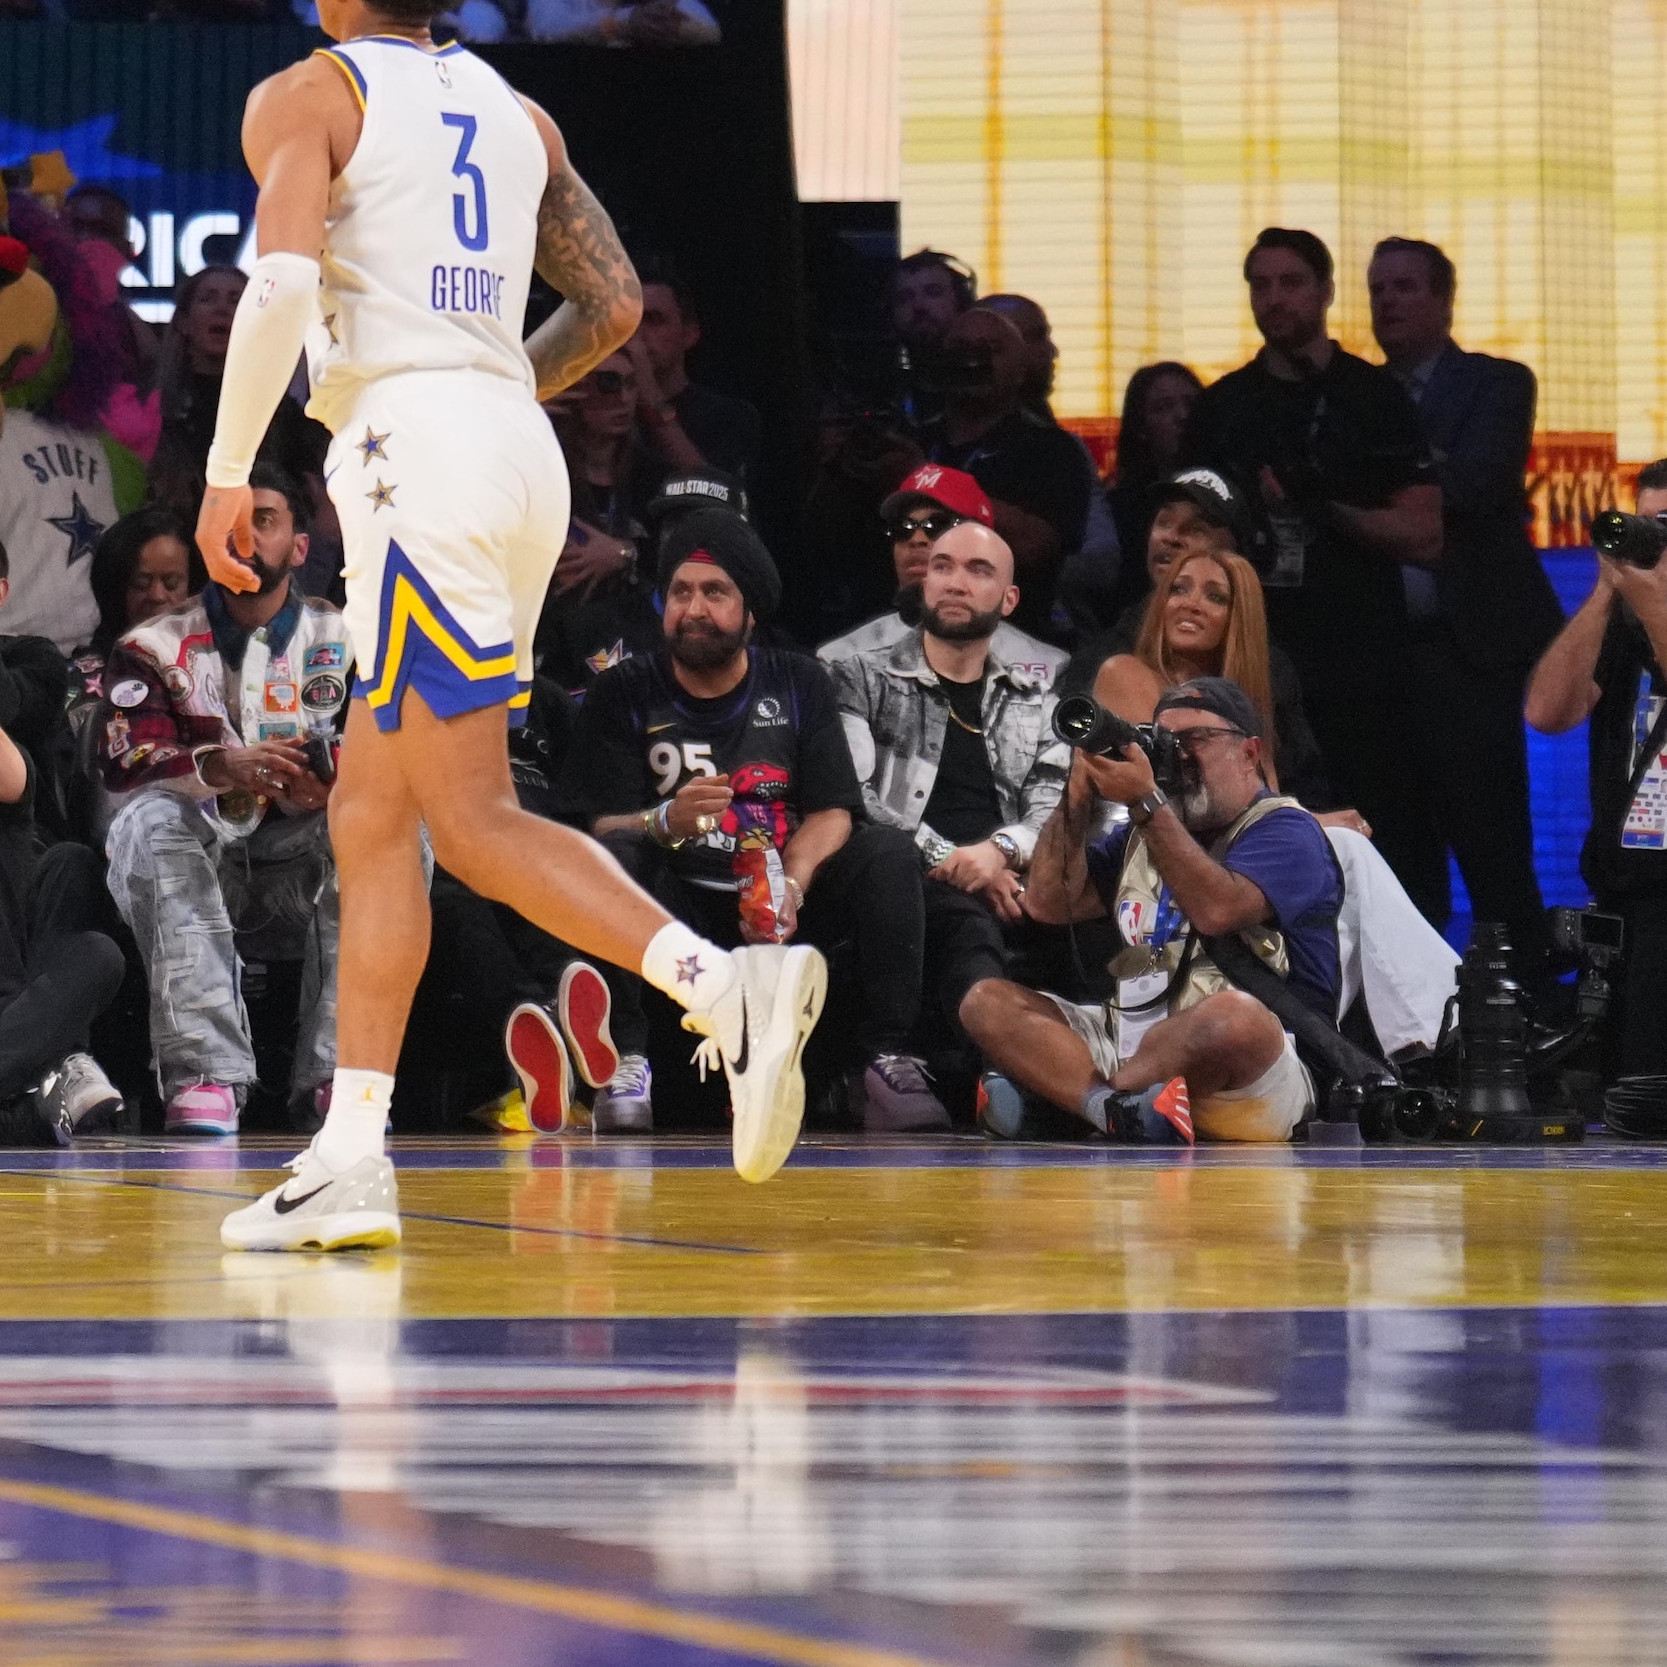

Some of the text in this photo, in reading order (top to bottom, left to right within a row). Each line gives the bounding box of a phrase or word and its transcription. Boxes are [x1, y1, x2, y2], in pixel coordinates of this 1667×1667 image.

[440, 111, 488, 252] 3
[22, 442, 98, 485] STUFF
[752, 716, 789, 728] Sun Life
[649, 741, 718, 796] 95
